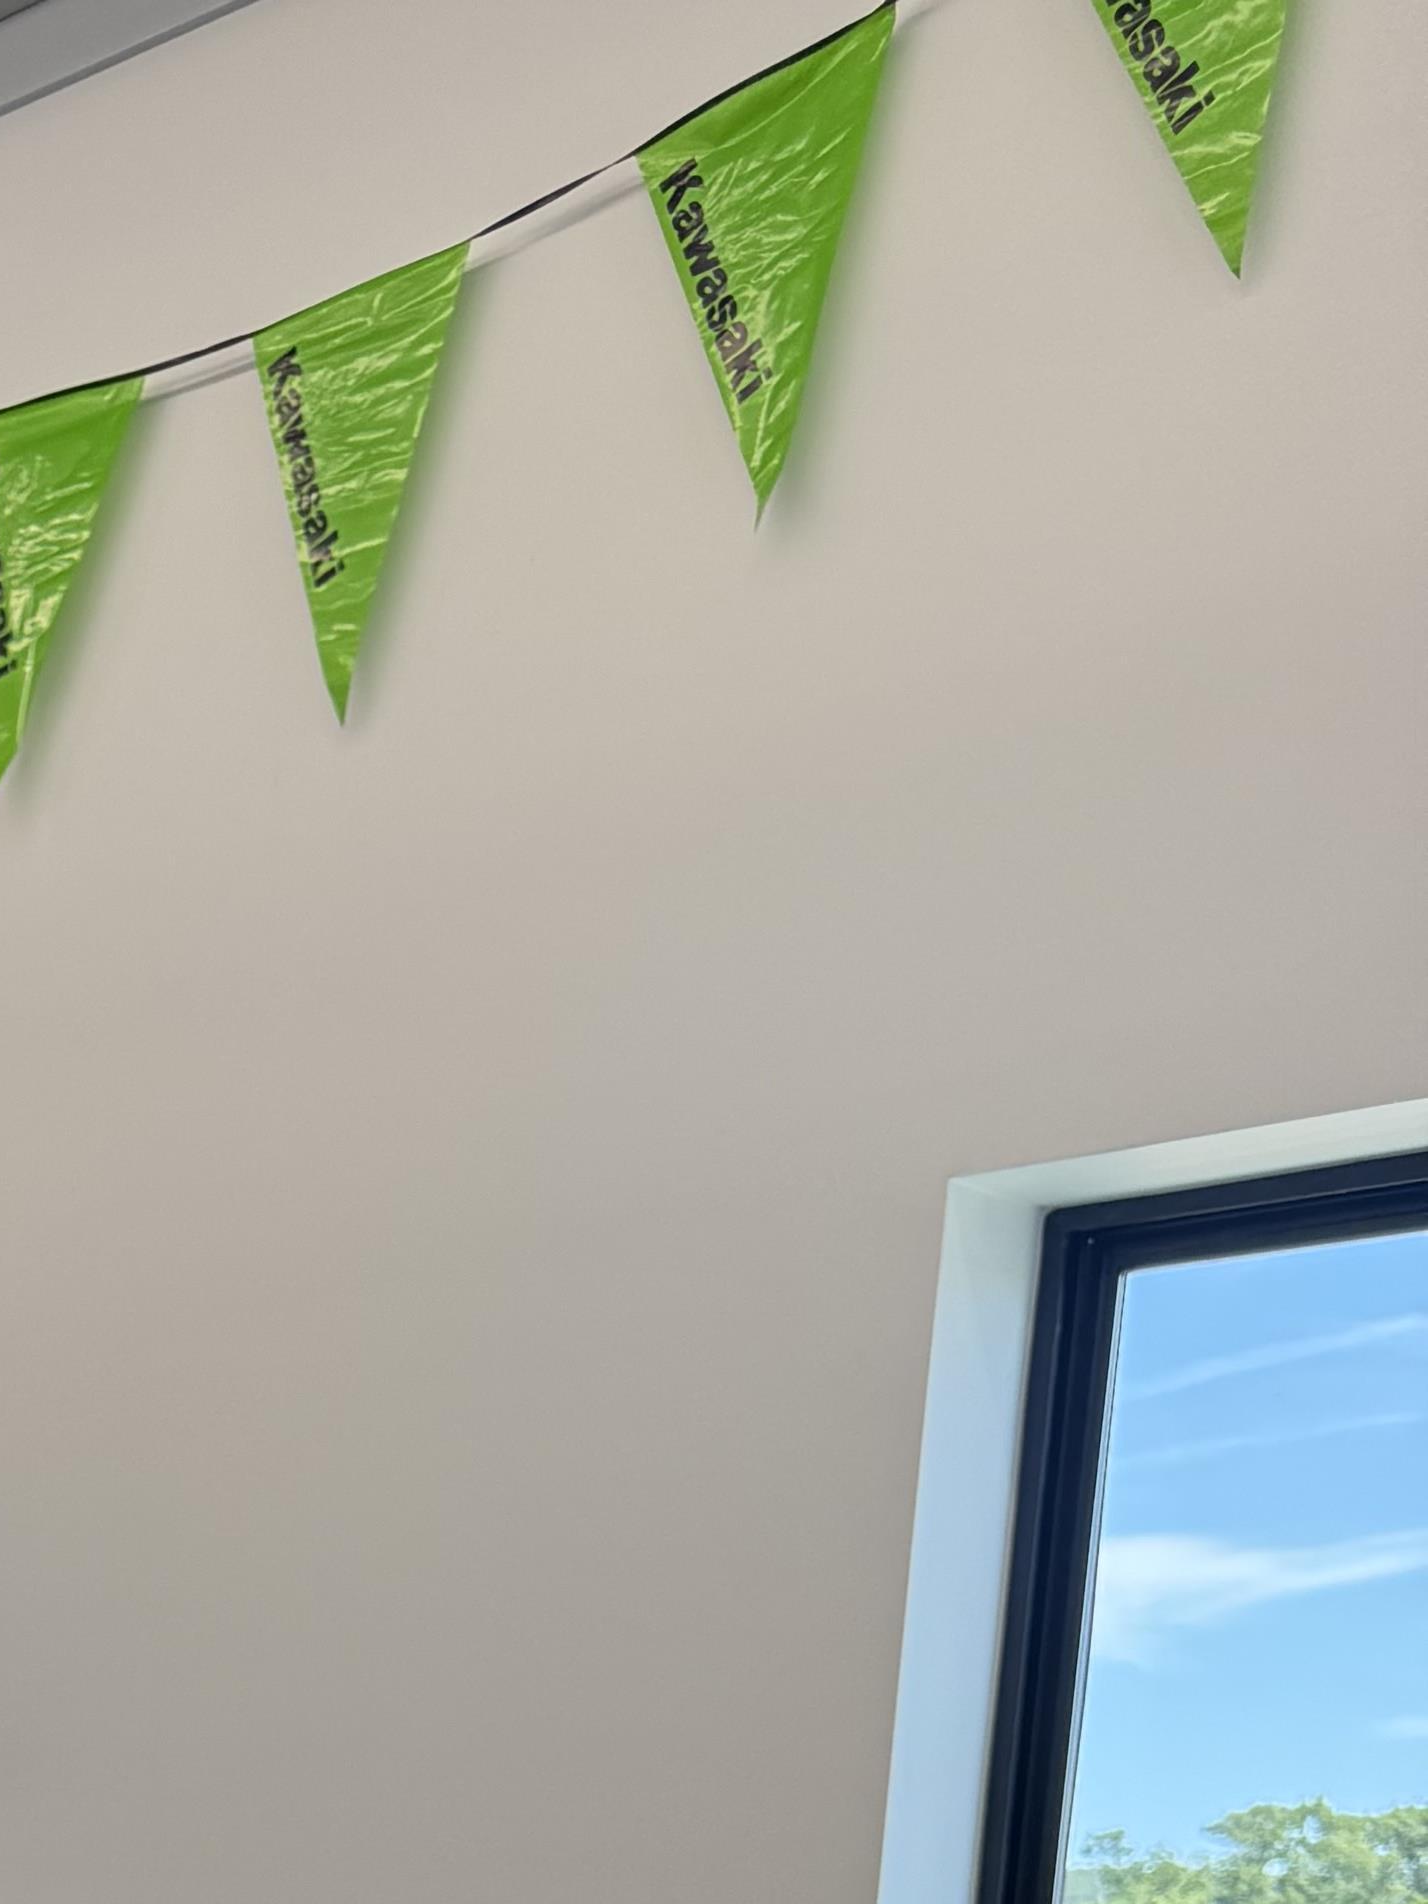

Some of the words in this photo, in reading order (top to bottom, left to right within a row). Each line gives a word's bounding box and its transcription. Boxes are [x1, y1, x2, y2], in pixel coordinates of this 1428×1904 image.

[1106, 0, 1215, 135] asaki
[659, 158, 773, 404] Kawasaki
[268, 346, 345, 588] Kawasaki
